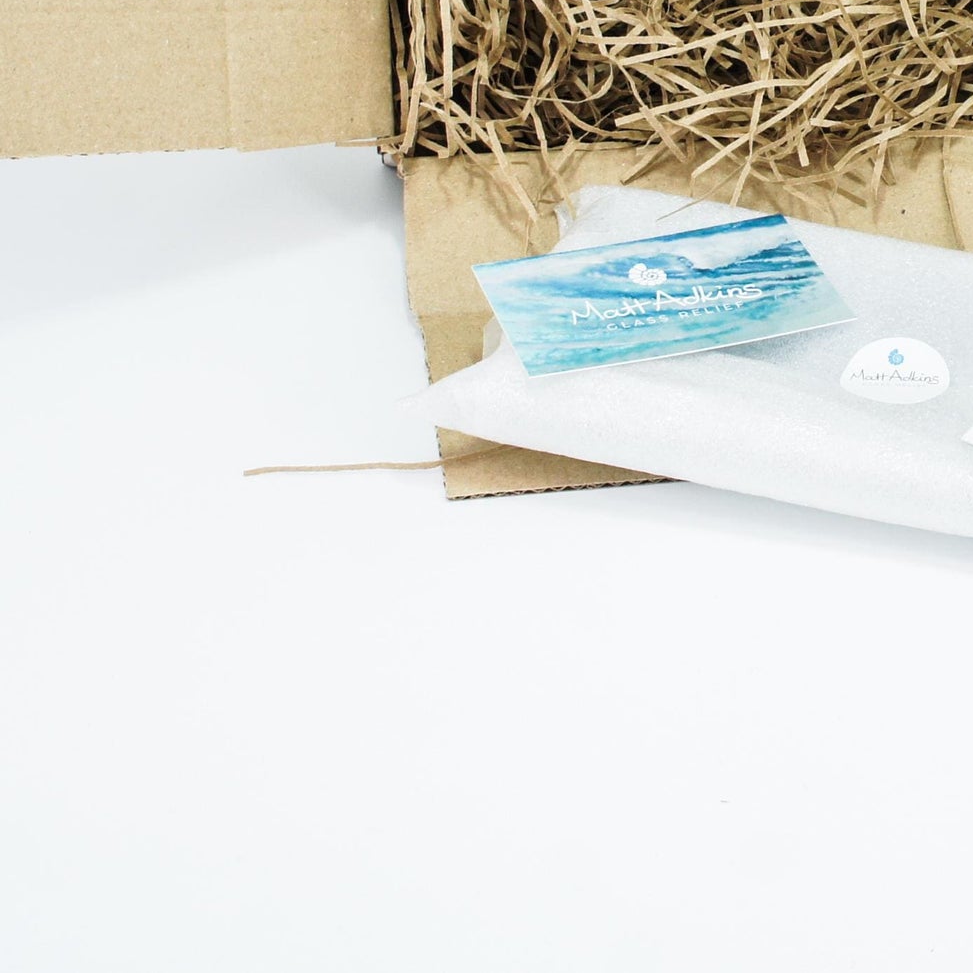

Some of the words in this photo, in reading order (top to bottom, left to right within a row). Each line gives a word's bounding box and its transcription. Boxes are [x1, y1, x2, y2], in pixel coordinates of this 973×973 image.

[571, 300, 648, 325] Matt
[653, 283, 762, 311] Adkins
[606, 314, 669, 331] GLASS
[678, 300, 744, 319] RELIEF
[850, 369, 888, 381] Matt
[888, 369, 940, 385] Adkins
